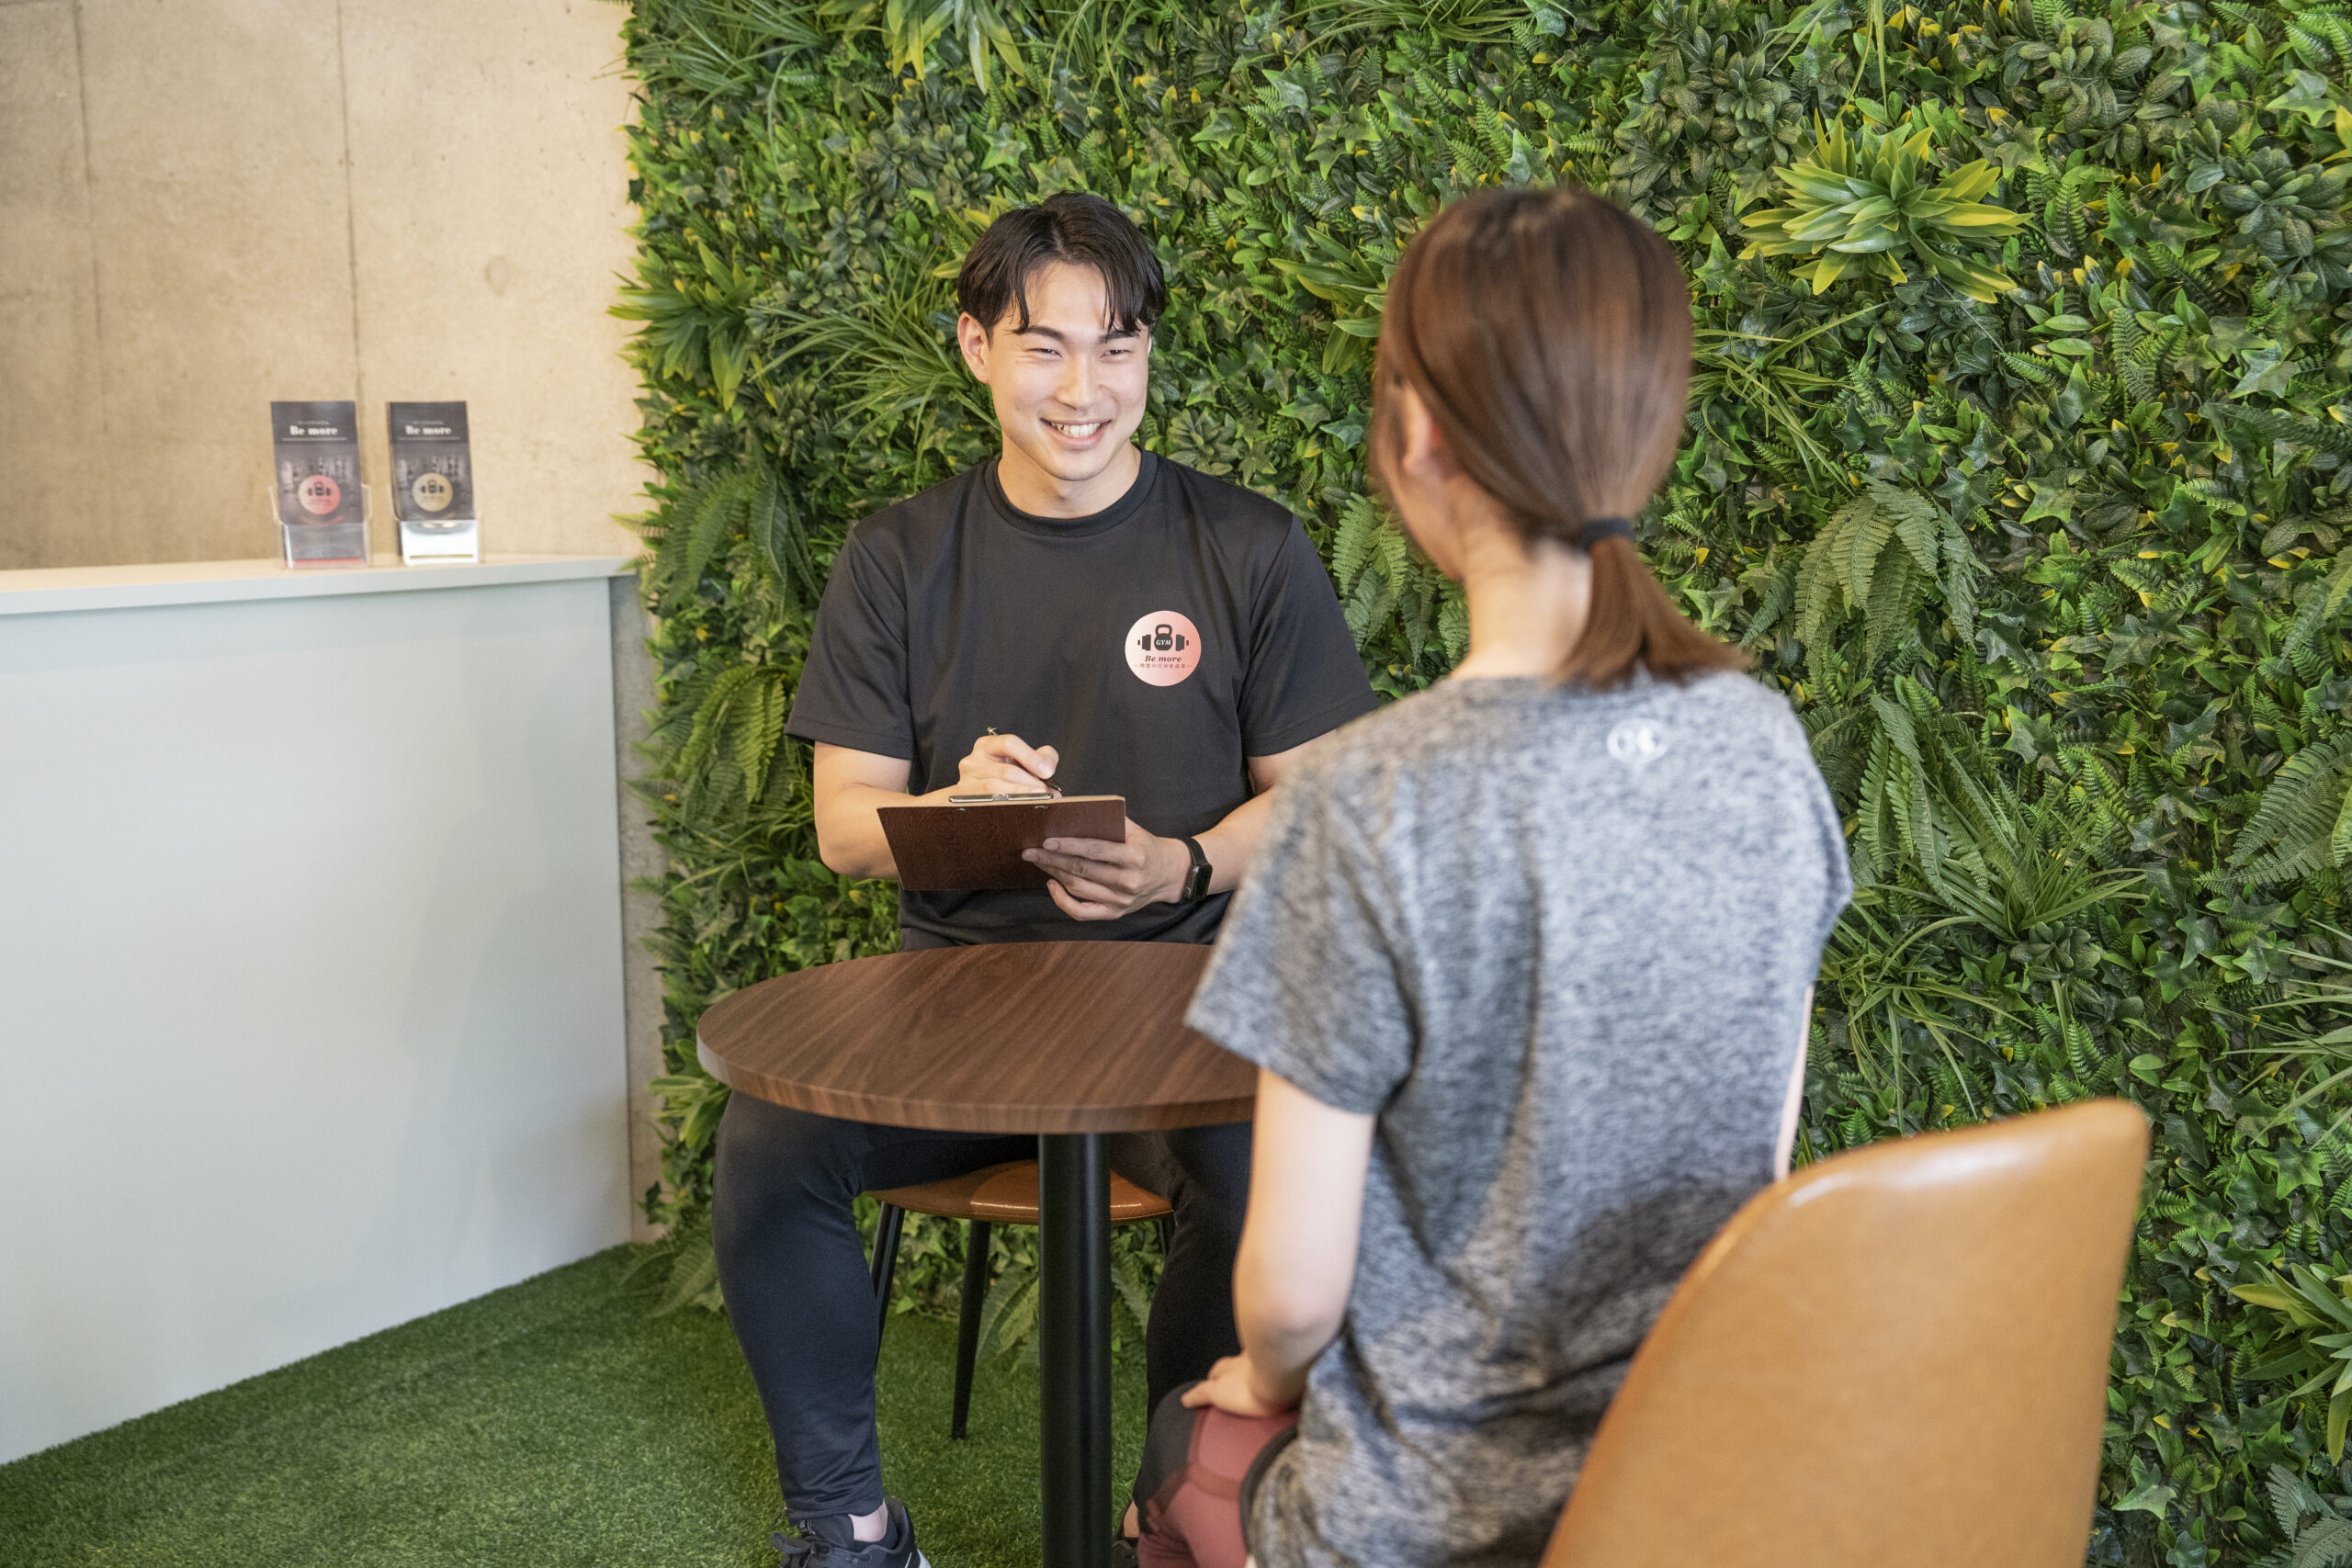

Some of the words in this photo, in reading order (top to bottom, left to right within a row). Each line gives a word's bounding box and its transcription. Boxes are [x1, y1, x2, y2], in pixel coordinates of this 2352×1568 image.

[289, 425, 305, 435] Be
[308, 426, 338, 435] more
[405, 424, 420, 434] Be
[423, 426, 452, 434] more
